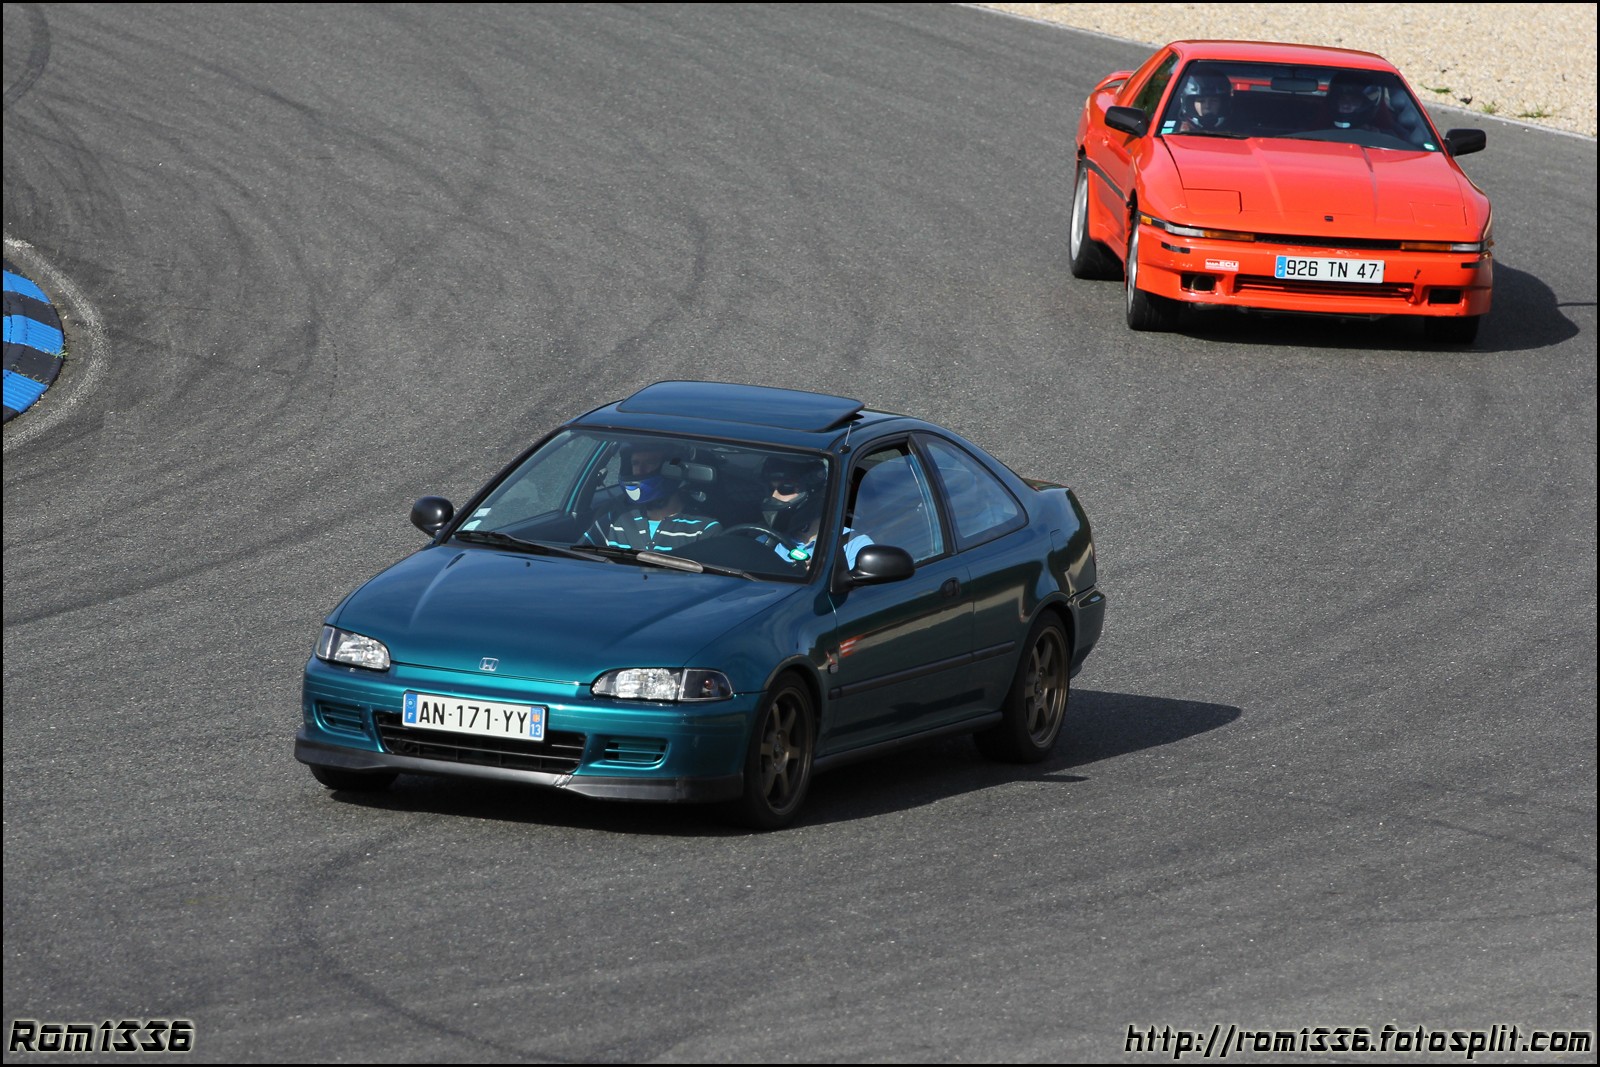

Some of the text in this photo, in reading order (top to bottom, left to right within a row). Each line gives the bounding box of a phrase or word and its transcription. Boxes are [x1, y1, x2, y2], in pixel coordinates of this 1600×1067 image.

[1286, 259, 1319, 277] 926
[1328, 261, 1348, 278] TN
[1356, 263, 1378, 279] 47
[418, 701, 528, 734] AN-171-YY
[530, 723, 542, 736] 13
